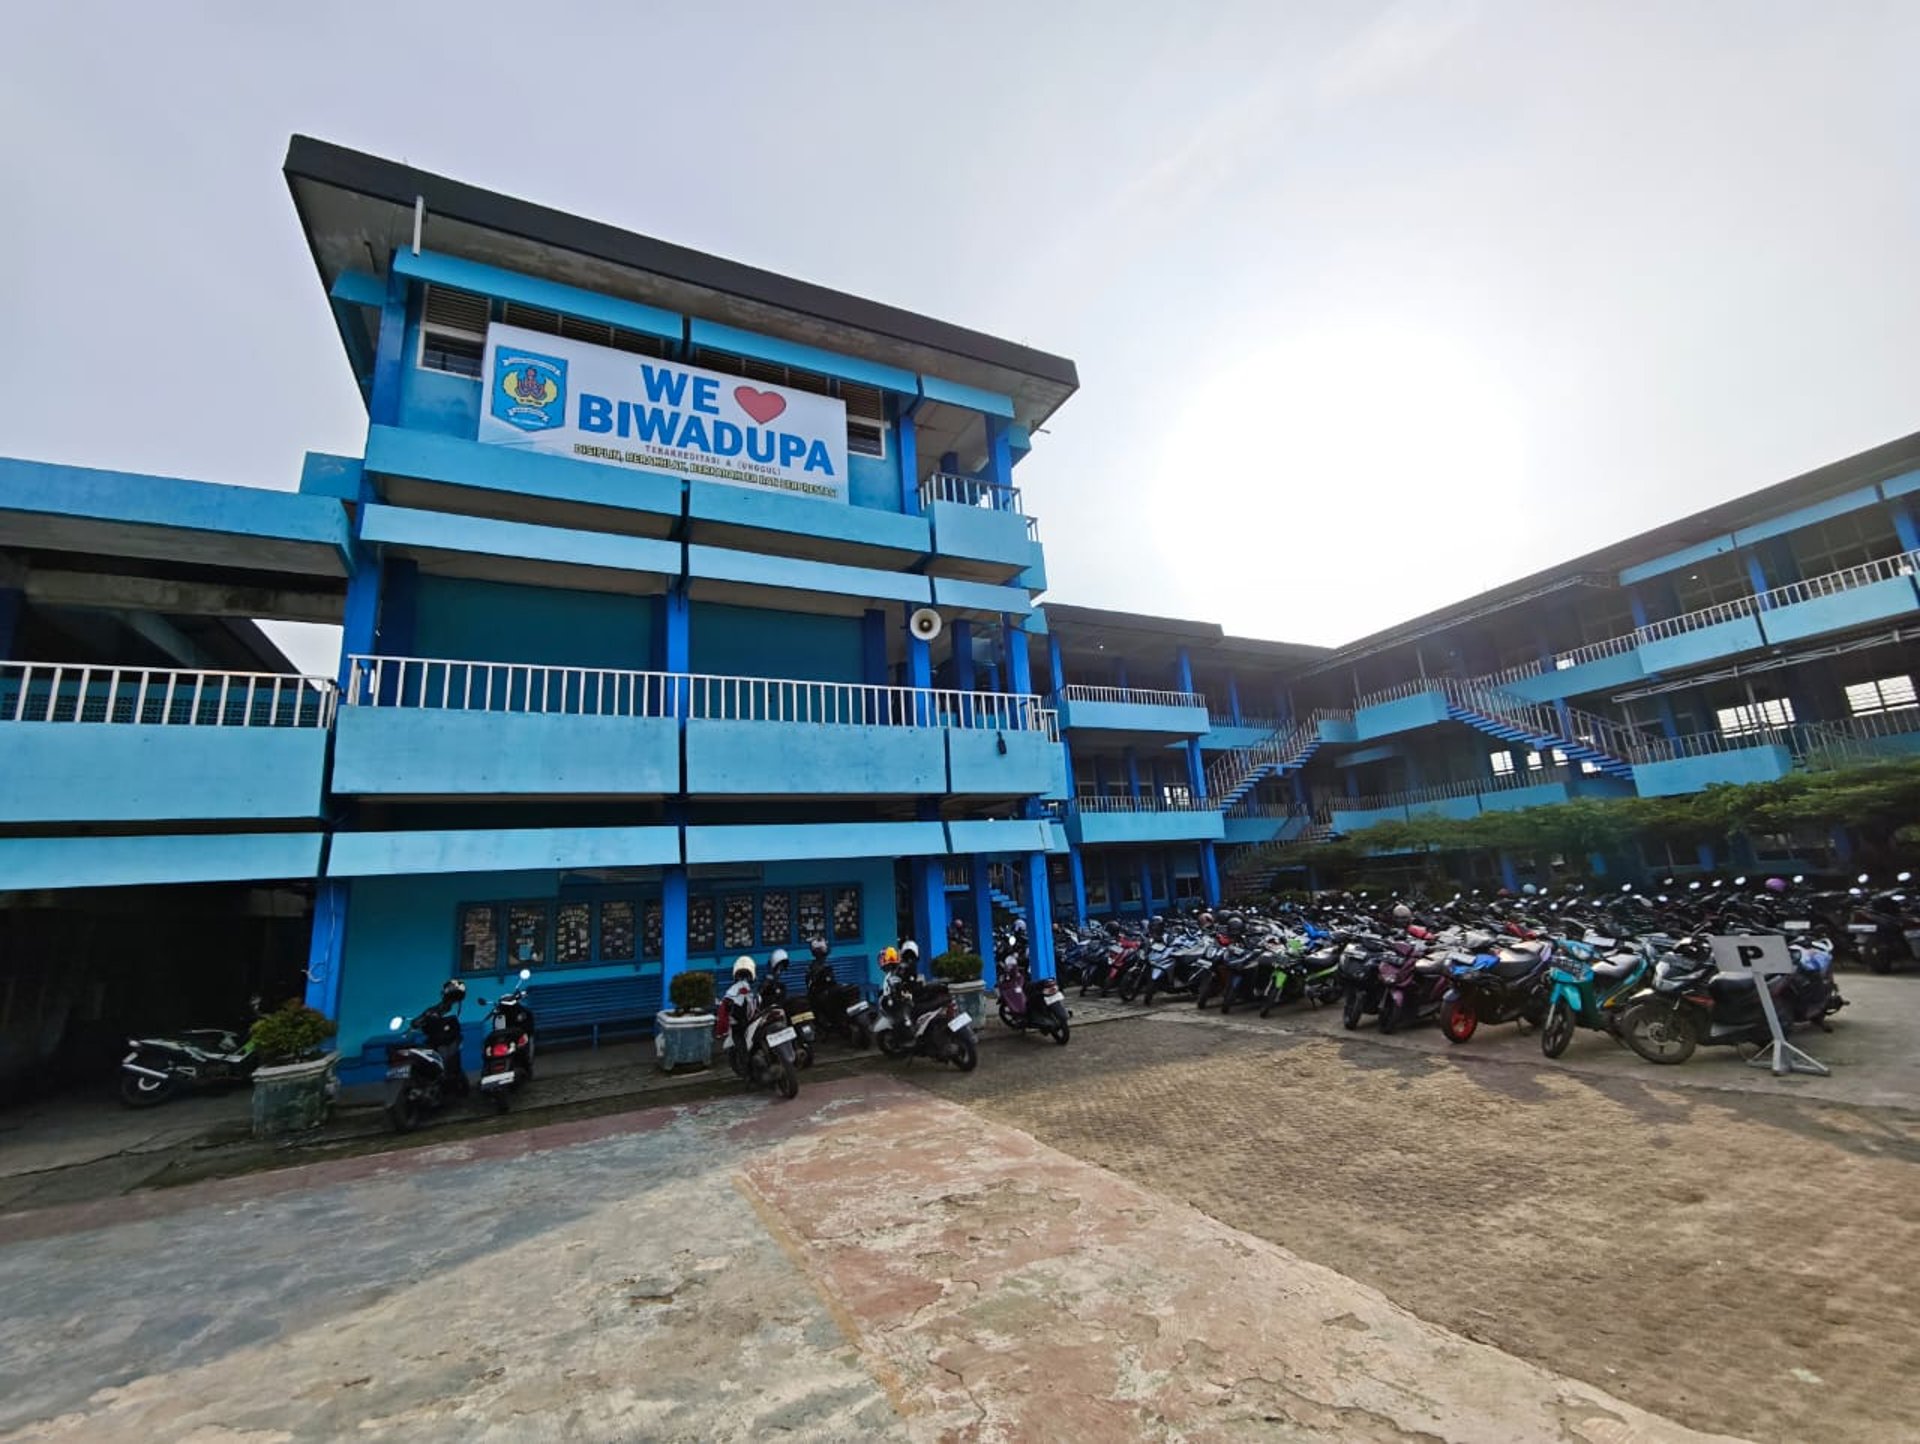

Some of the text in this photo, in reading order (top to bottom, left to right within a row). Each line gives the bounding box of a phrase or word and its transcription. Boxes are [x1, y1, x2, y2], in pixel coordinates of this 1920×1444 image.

[641, 364, 719, 414] WE
[578, 392, 835, 476] BIWADUPA
[645, 444, 719, 465] TERAKREDITASI
[1737, 945, 1764, 968] P
